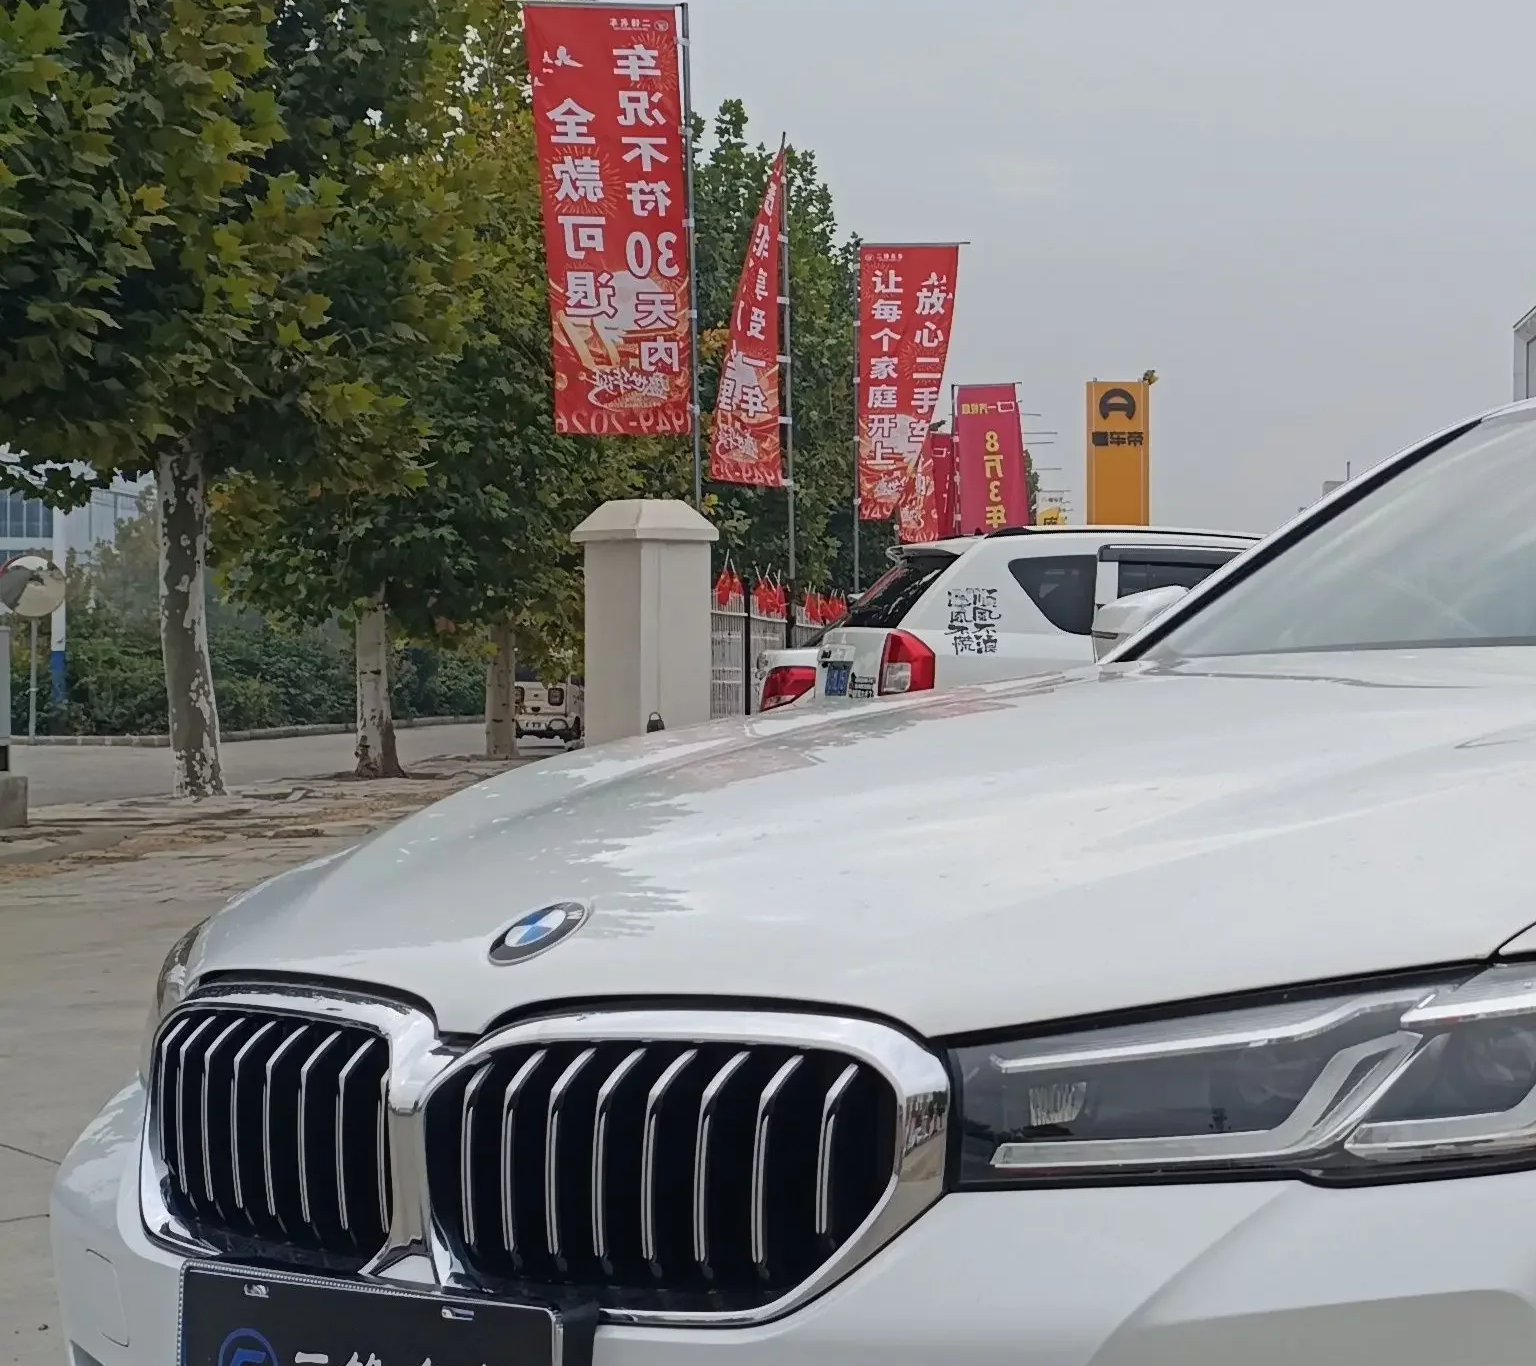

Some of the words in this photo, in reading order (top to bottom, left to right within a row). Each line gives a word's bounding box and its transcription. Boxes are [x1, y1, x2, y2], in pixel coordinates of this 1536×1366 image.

[866, 269, 903, 465] 让每个家庭开上
